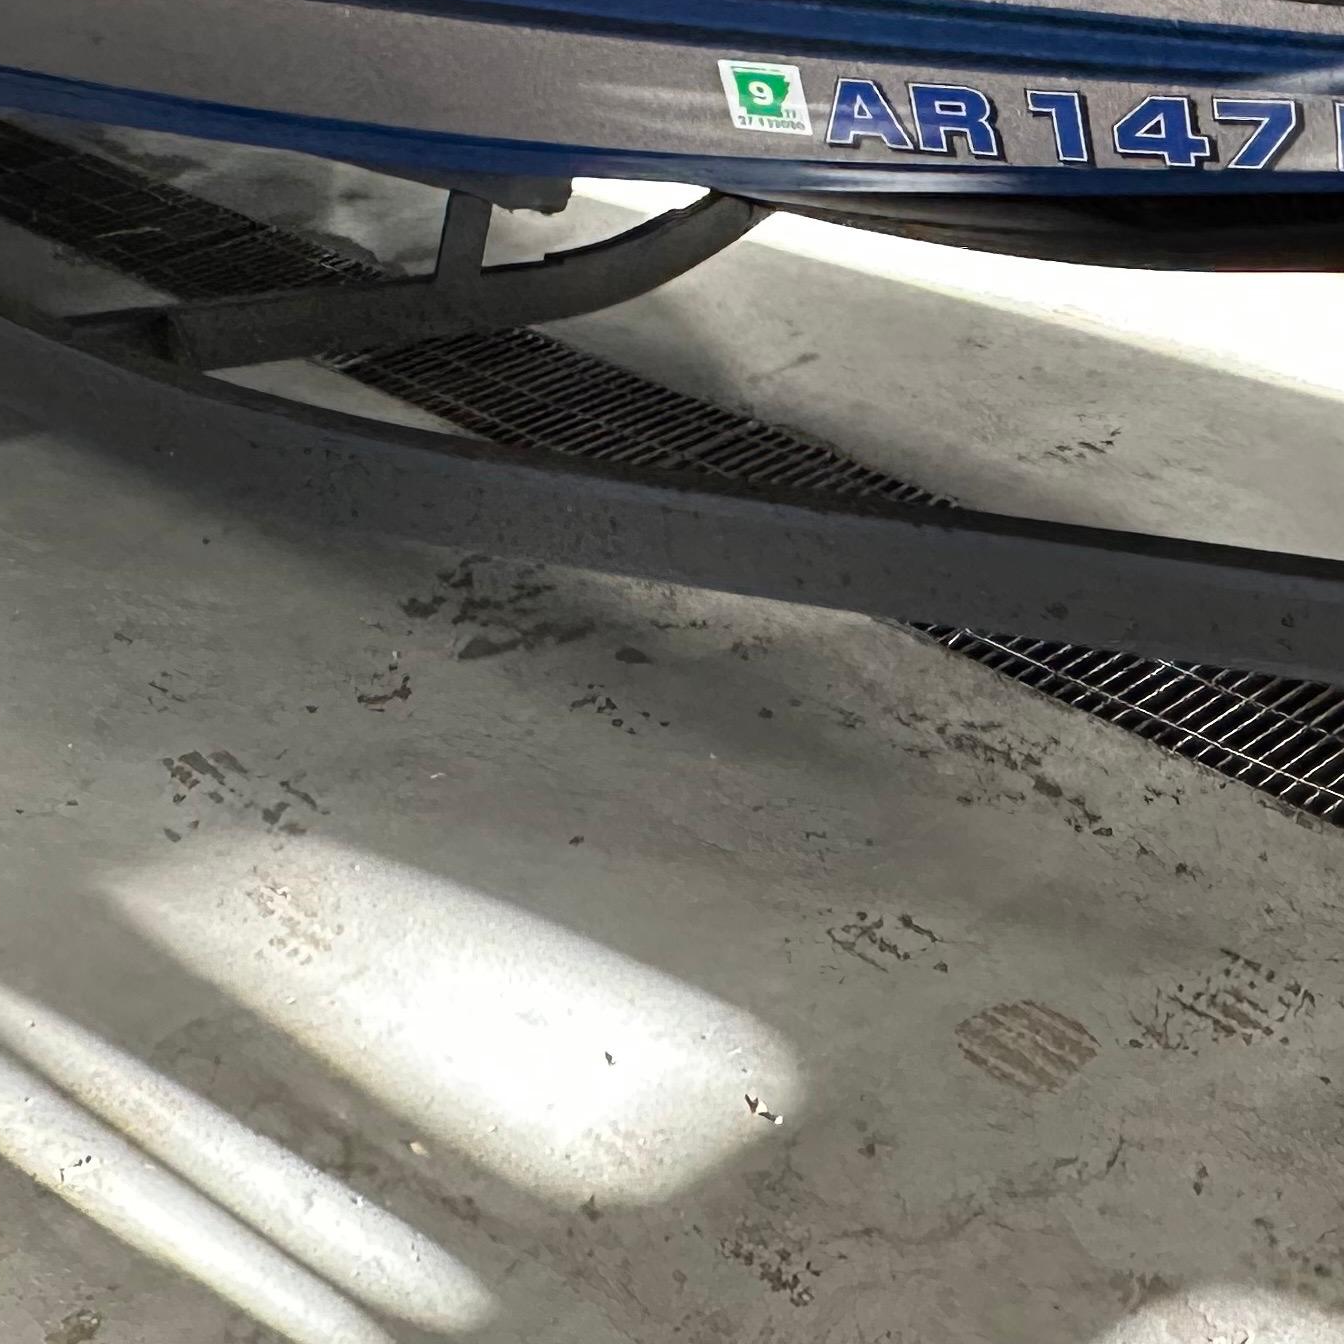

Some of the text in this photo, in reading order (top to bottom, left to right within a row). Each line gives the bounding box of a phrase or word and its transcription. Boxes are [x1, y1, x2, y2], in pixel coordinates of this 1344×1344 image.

[748, 80, 775, 106] 9
[825, 76, 1002, 158] AR
[1024, 89, 1302, 171] 147
